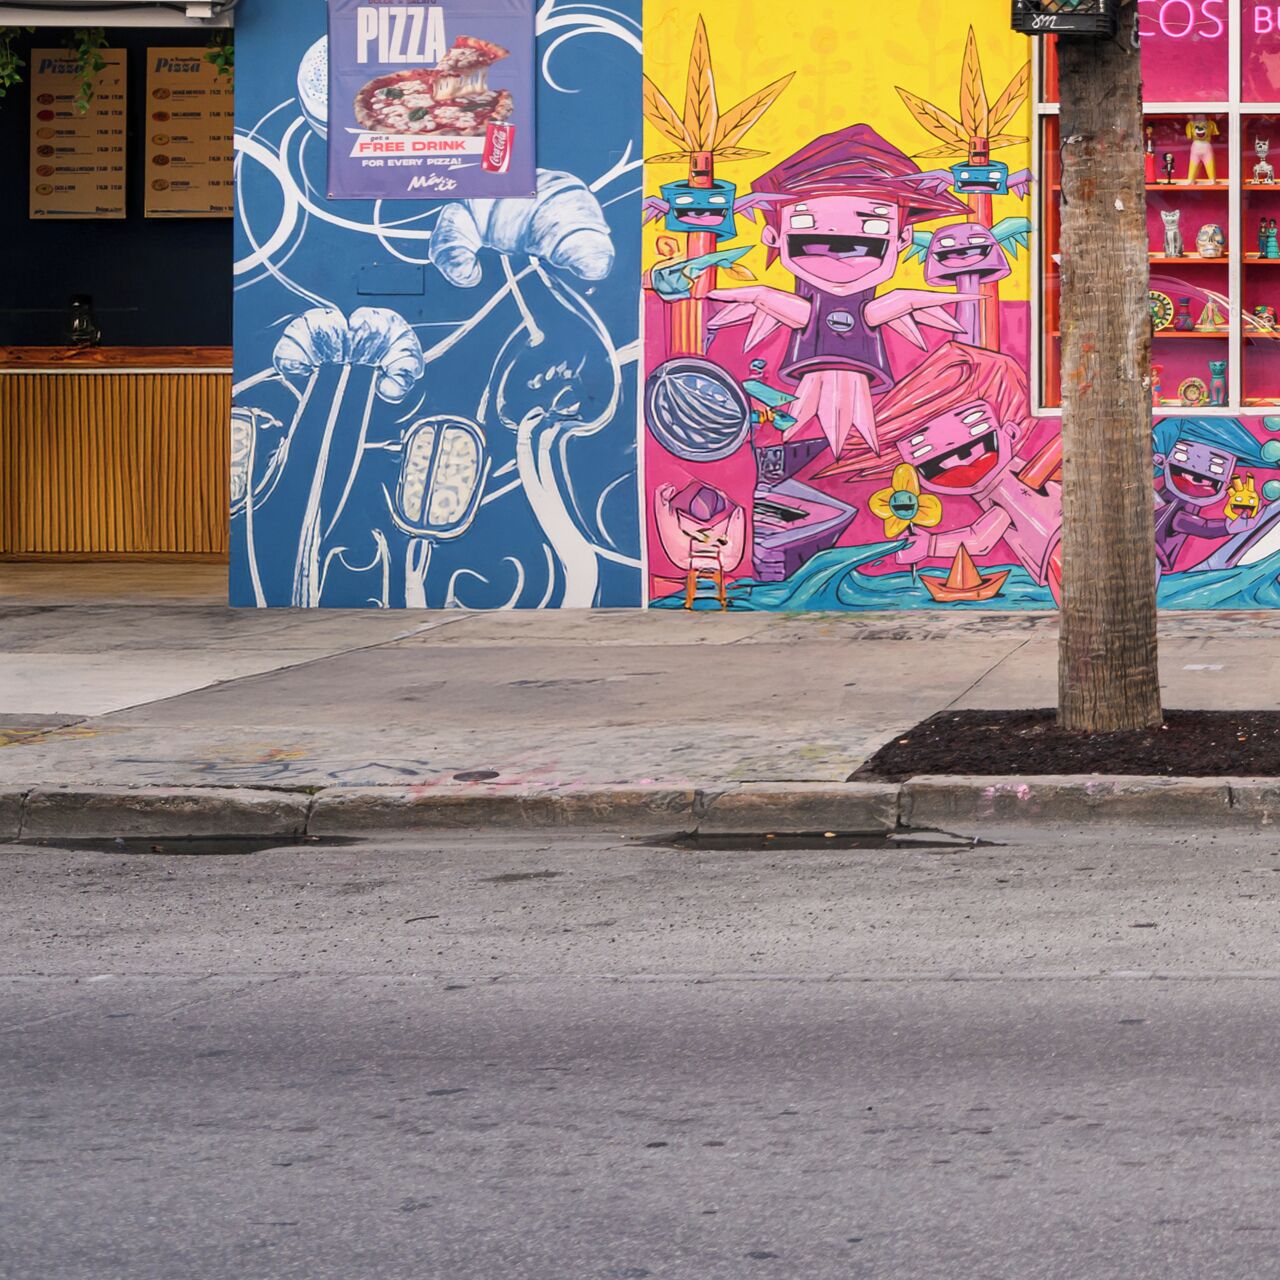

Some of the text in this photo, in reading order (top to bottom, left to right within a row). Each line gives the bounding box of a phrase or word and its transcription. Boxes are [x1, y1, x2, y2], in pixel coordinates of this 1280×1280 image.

[357, 6, 447, 64] PIZZA
[359, 140, 466, 153] FREE DRINK
[362, 157, 462, 168] FOR EVERY PIZZA!
